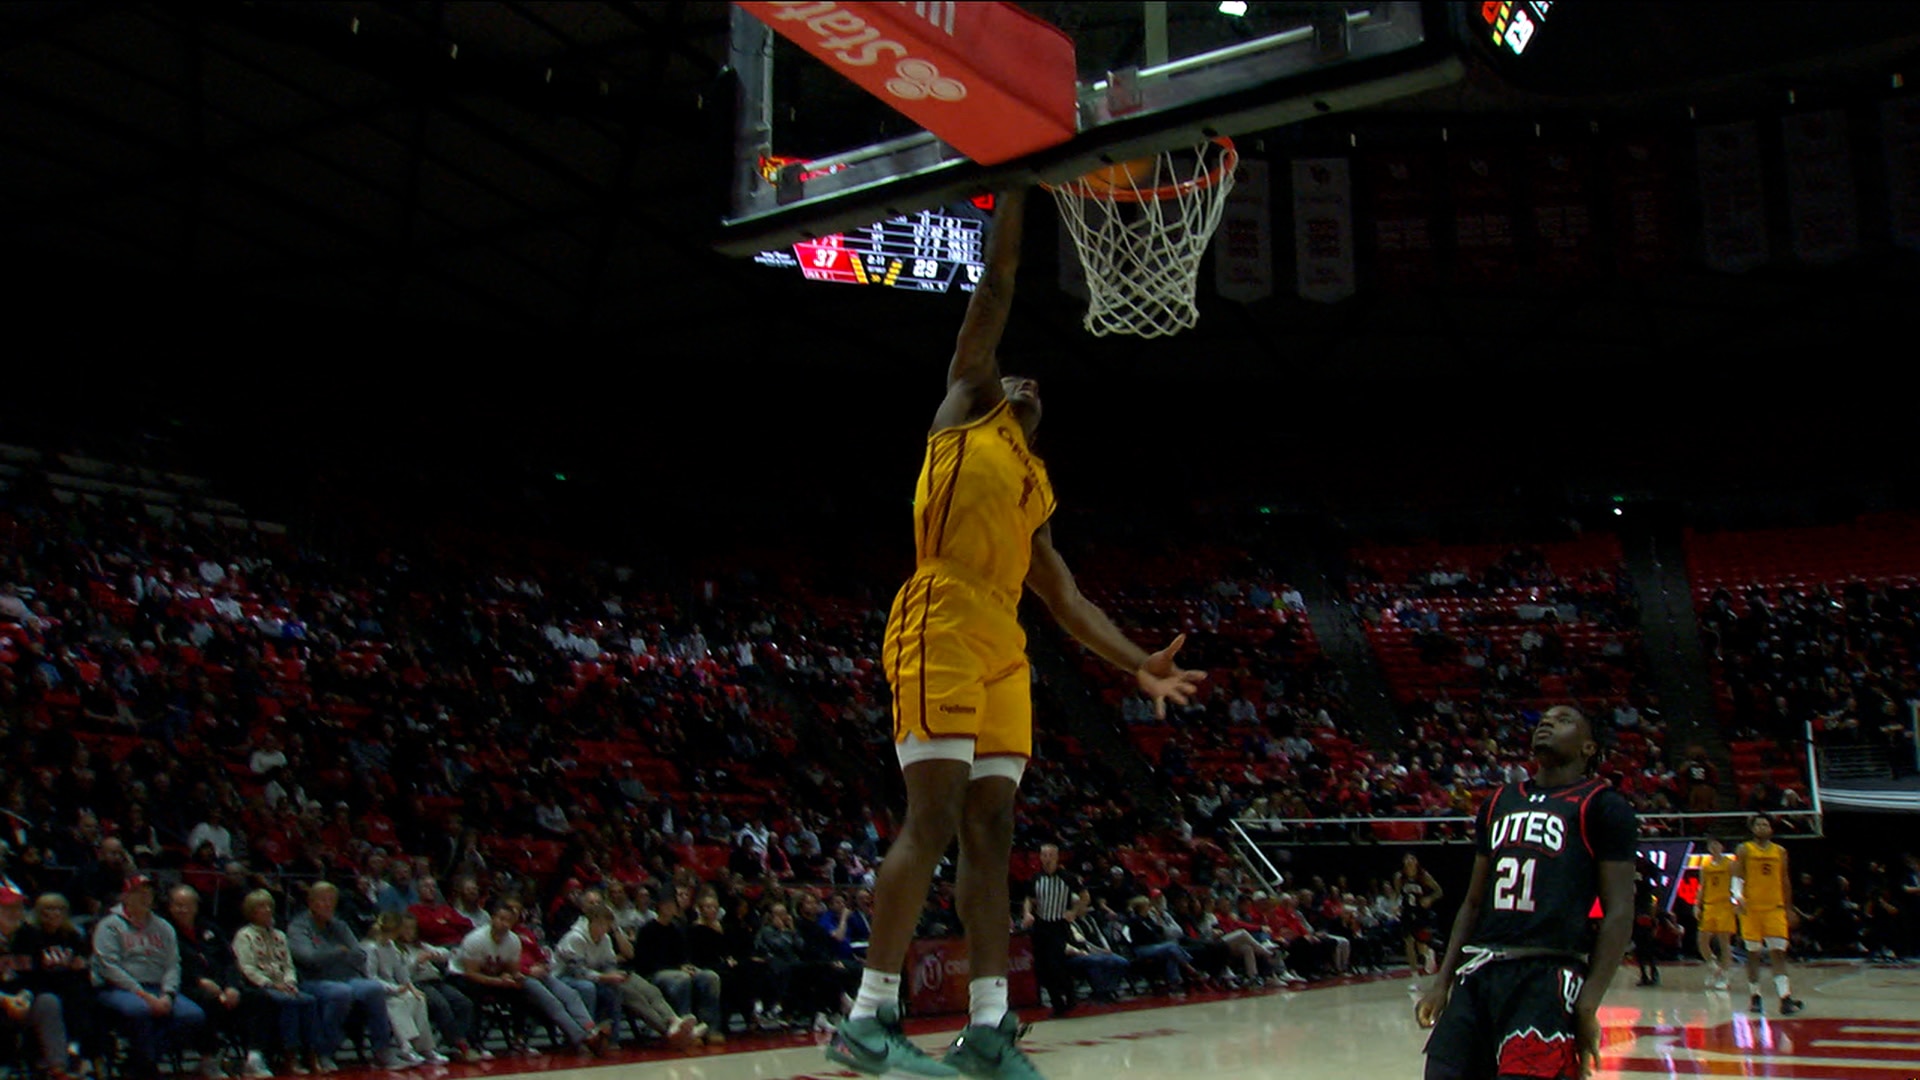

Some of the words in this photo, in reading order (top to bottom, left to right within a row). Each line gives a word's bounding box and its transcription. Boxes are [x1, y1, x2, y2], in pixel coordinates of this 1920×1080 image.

[767, 0, 908, 66] Stat
[813, 249, 838, 269] 37
[913, 258, 938, 278] 29
[1491, 811, 1565, 851] UTES
[1494, 856, 1536, 912] 21
